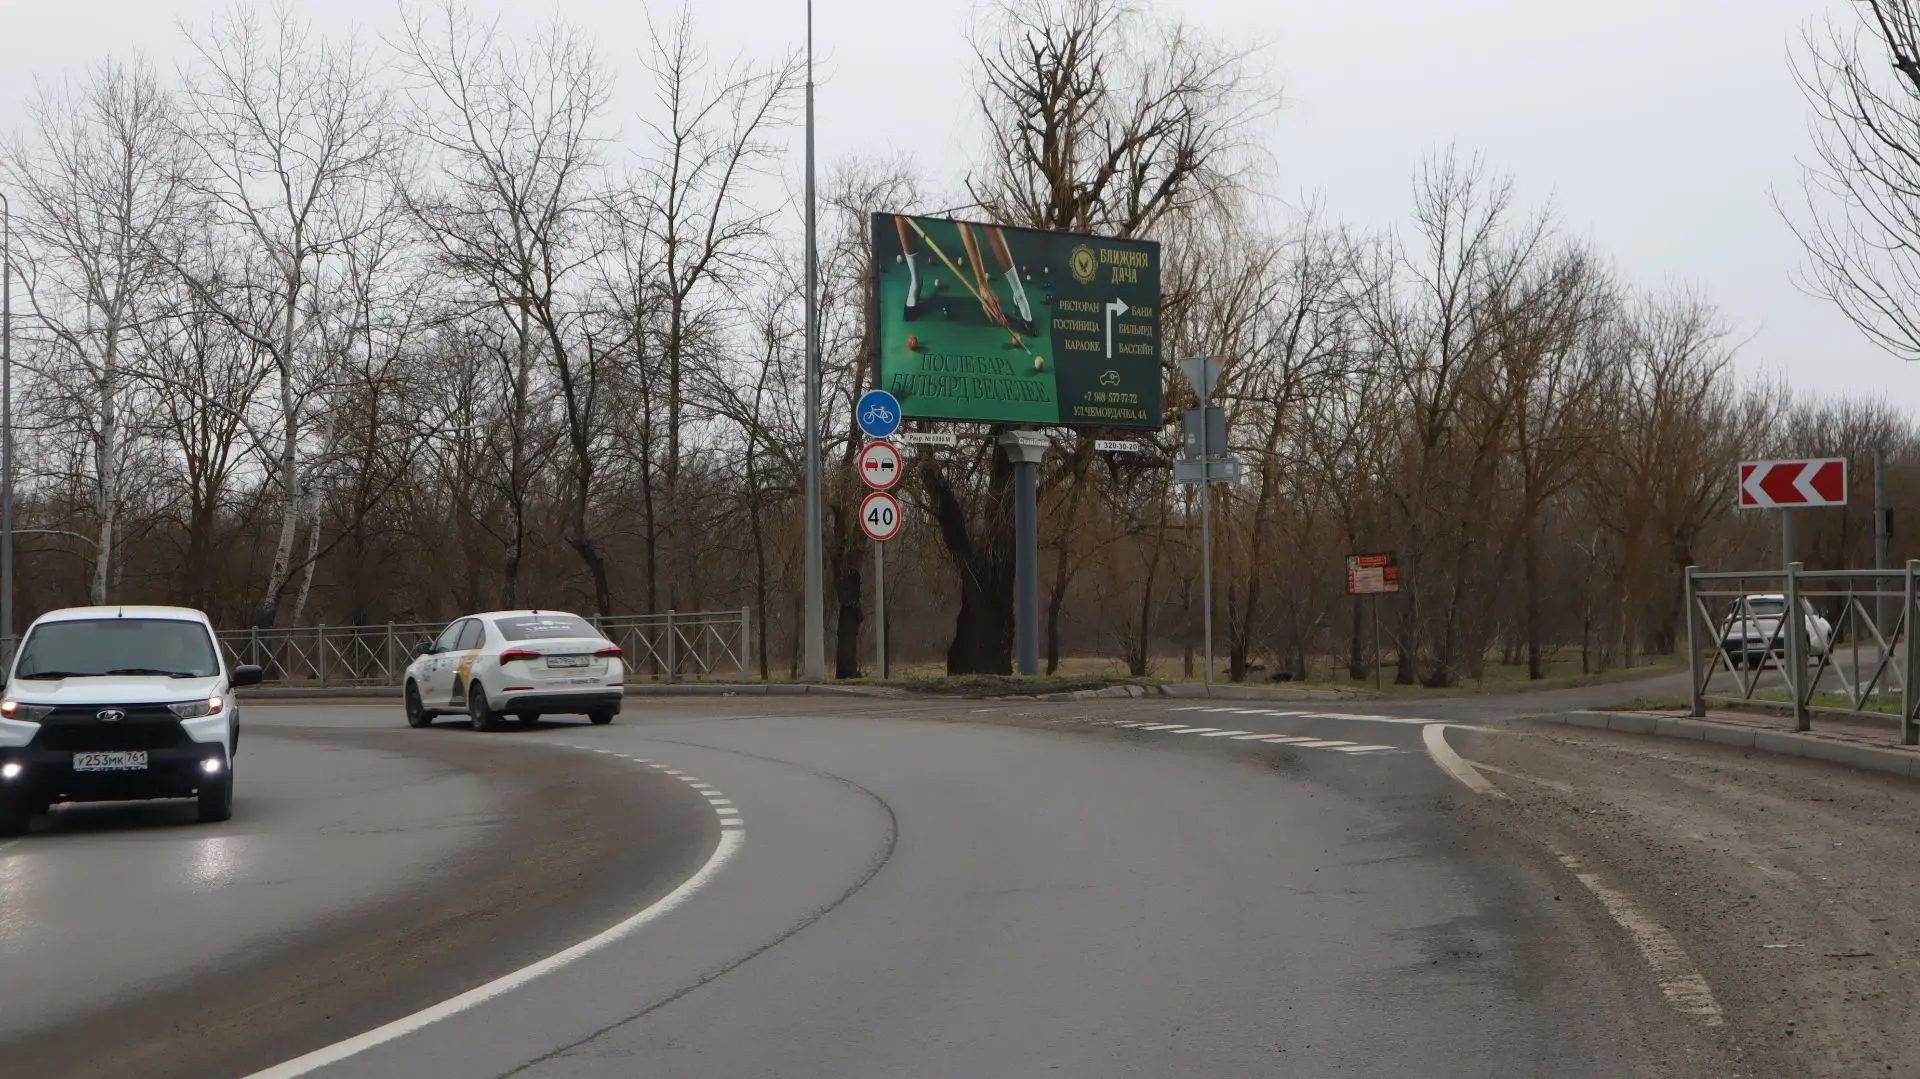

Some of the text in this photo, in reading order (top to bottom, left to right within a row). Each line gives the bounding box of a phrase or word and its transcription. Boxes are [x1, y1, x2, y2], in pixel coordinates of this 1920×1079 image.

[1100, 249, 1148, 268] БЛИЖНЯЯ
[1112, 267, 1137, 284] ДАЧА
[1060, 300, 1099, 312] РЕСТОРАН
[1131, 306, 1152, 316] БАНИ
[1053, 319, 1099, 332] ГОСТИНИЦА
[1119, 324, 1152, 337] БИЛЬЯРД
[1065, 340, 1100, 352] КАРАОКЕ
[1119, 343, 1153, 355] БАССЕЙН
[922, 353, 1016, 376] ПОСЛЕ БАРА
[889, 374, 1051, 405] БИЛЬЯРД ВЕСЕЛЕЕ
[1103, 441, 1138, 450] 320-30-20
[867, 507, 893, 526] 40
[126, 752, 146, 763] 761
